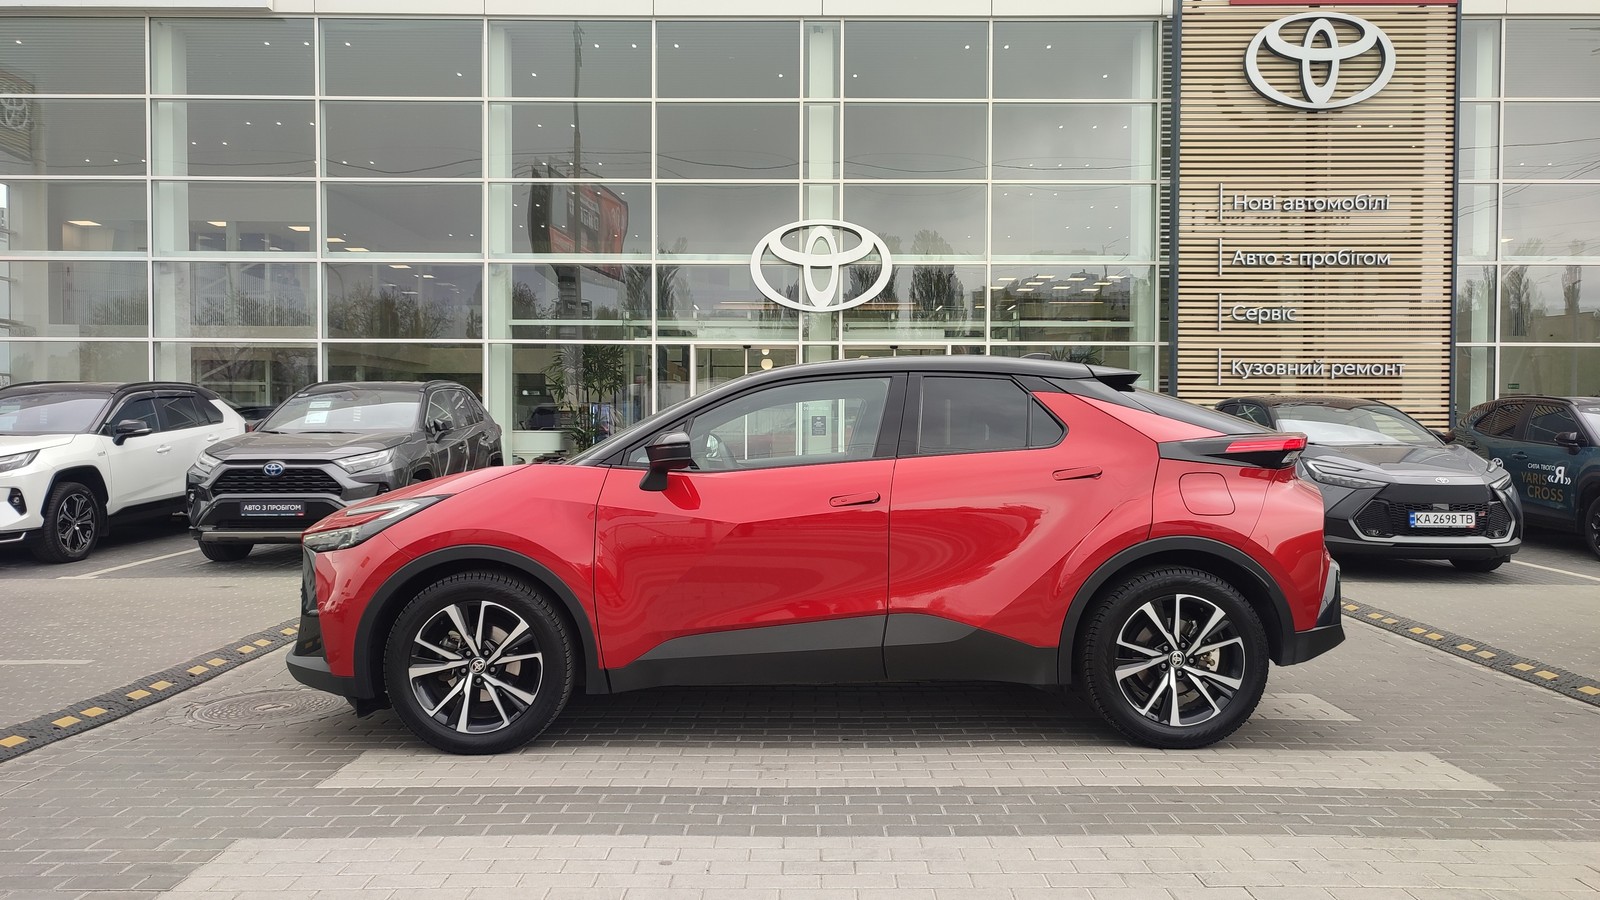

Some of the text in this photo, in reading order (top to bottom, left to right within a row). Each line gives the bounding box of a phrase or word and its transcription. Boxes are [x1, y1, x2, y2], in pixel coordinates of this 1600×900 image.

[1233, 193, 1390, 211] Нові автомобілі
[1232, 249, 1391, 270] Авто з пробігом
[1231, 304, 1297, 325] Сервіс
[1231, 360, 1406, 379] Кузовний ремонт
[1521, 472, 1547, 486] YARIS
[1527, 485, 1564, 502] CROSS
[1433, 514, 1457, 524] 2698
